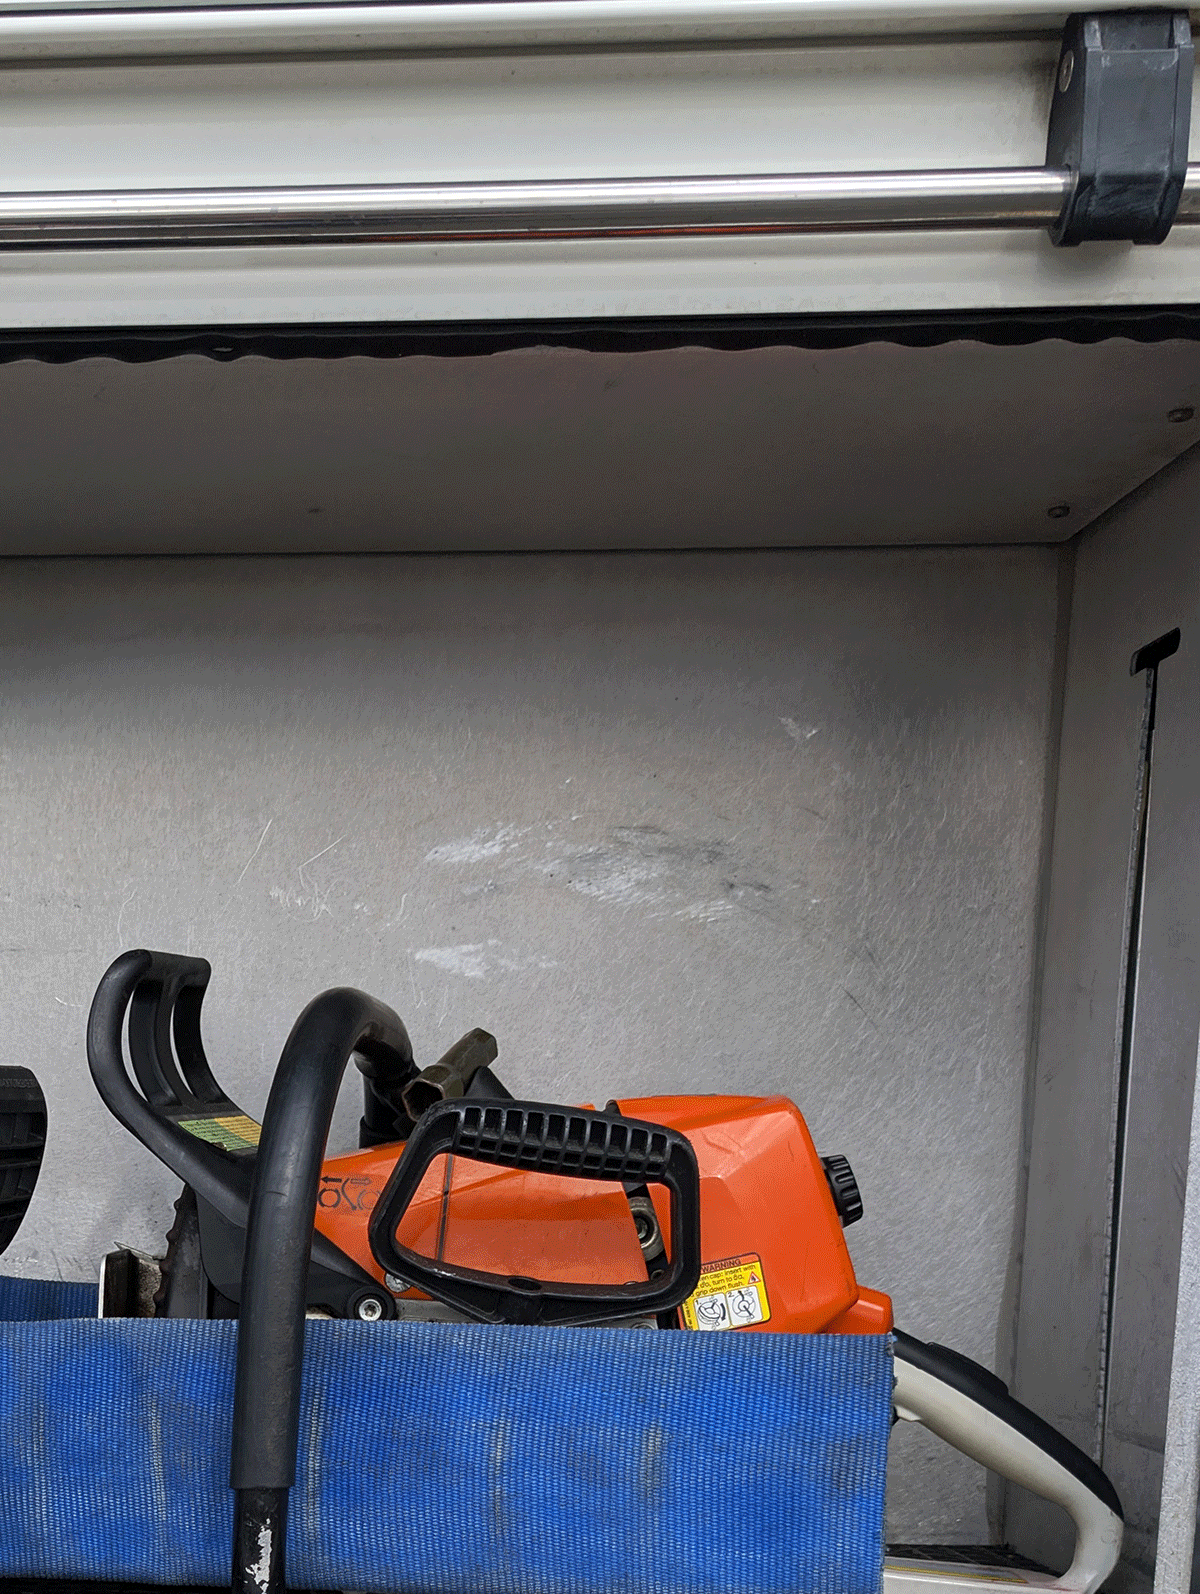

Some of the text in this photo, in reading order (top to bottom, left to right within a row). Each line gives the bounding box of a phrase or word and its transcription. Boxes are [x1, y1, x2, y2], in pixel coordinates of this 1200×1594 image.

[701, 1258, 741, 1273] WARNING
[725, 1267, 742, 1276] insert
[695, 1289, 708, 1298] grip
[709, 1285, 726, 1293] down
